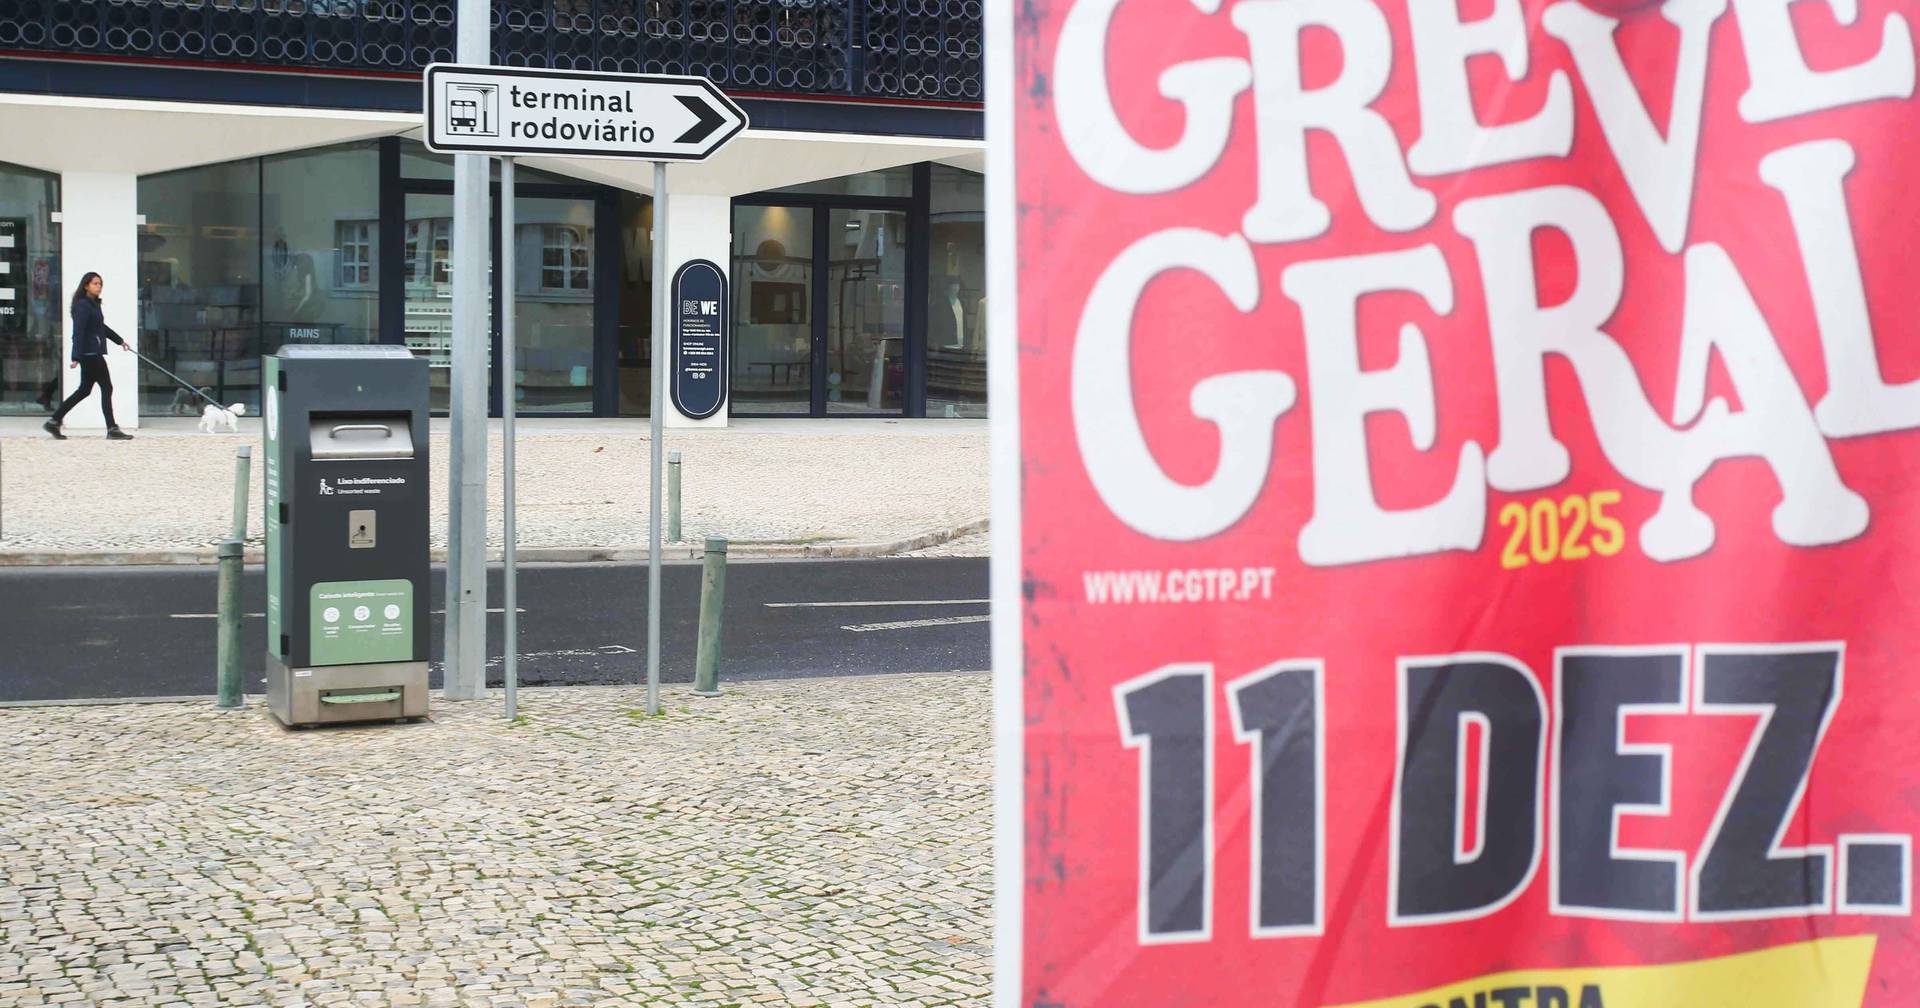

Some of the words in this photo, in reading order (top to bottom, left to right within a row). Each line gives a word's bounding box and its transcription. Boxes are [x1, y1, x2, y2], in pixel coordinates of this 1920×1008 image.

[510, 85, 634, 113] terminal
[510, 116, 655, 143] rodoviário
[1052, 0, 1917, 253] GREVE
[682, 299, 699, 315] BE
[700, 300, 718, 316] WE
[290, 328, 320, 338] RAINS
[1070, 138, 1920, 568] GERAL
[353, 477, 406, 485] indiferenciado
[1499, 491, 1625, 568] 2025
[1082, 566, 1276, 605] WWW.CGTP.PT
[1113, 658, 1326, 946] 11
[1387, 640, 1913, 928] DEZ.
